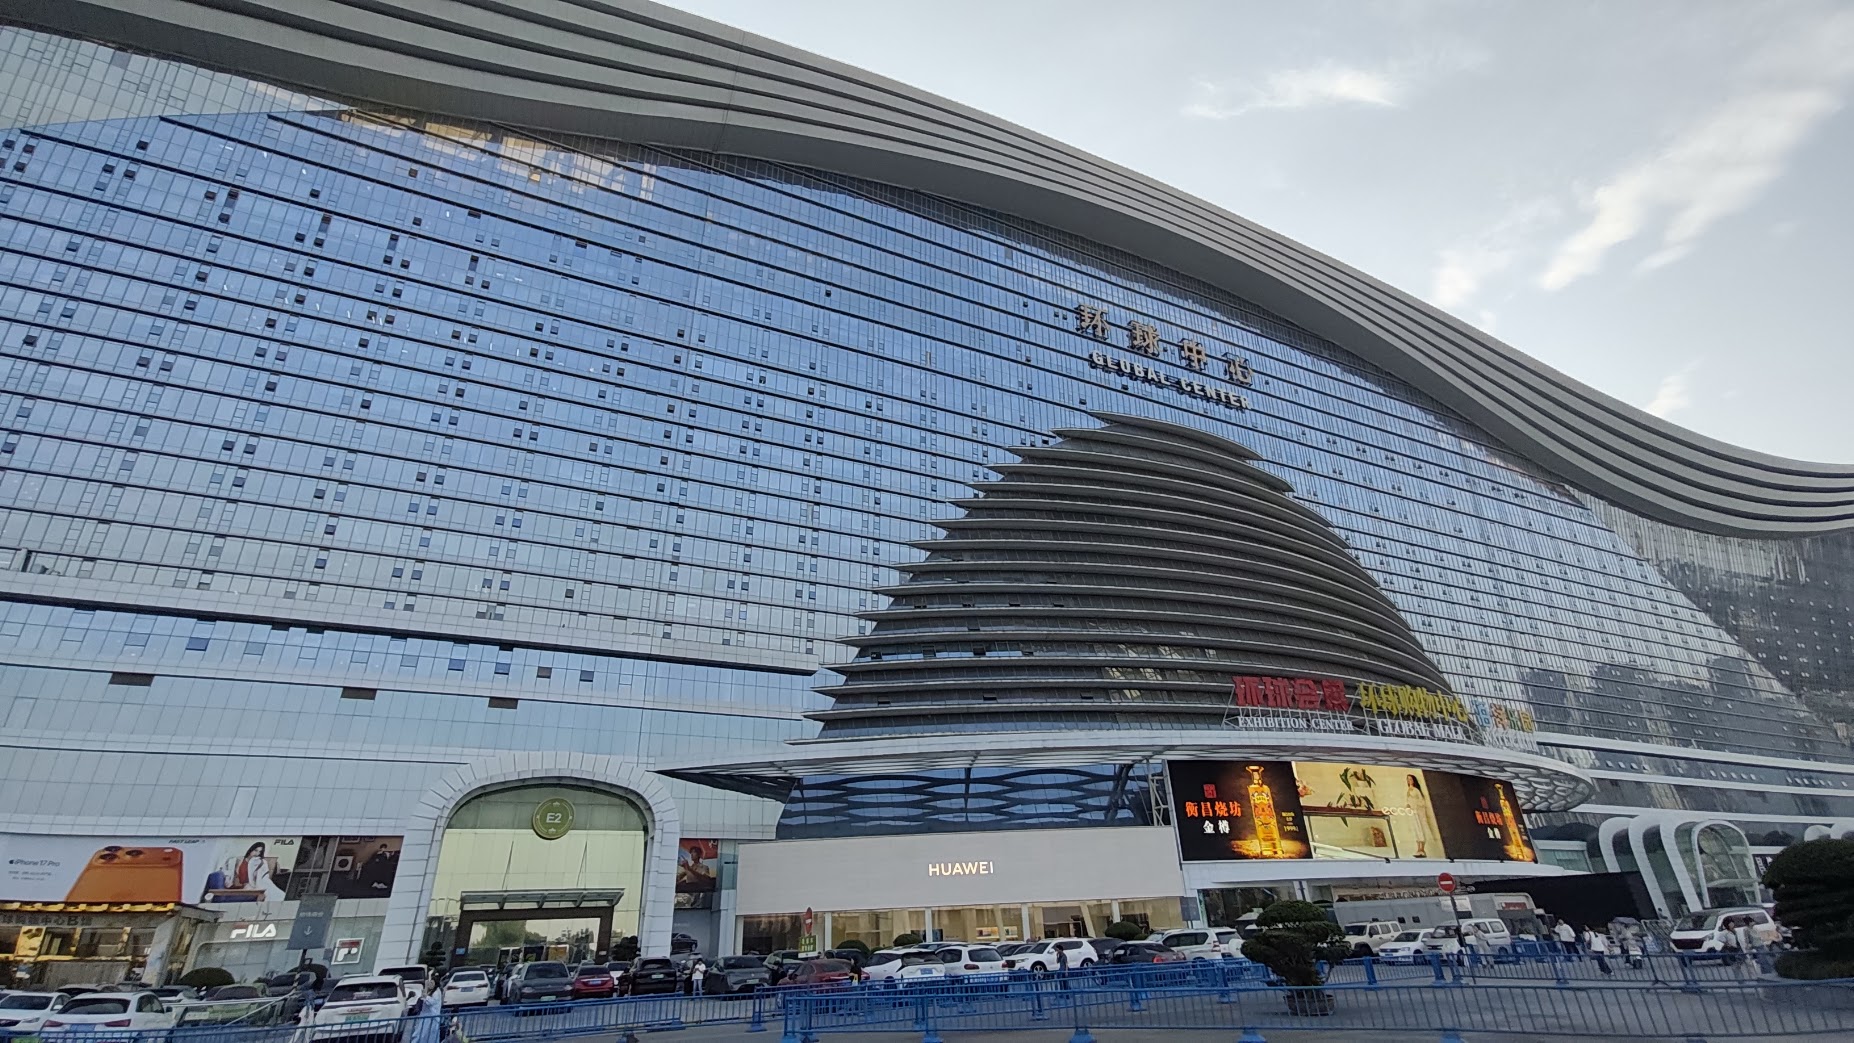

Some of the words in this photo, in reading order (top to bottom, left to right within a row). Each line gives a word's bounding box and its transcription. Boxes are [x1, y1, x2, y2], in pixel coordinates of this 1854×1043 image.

[1077, 304, 1255, 386] 环球中心
[1092, 350, 1171, 386] GLOBAL
[1180, 378, 1251, 409] CENTER
[1232, 676, 1351, 711] 环球会展
[1356, 681, 1469, 722] 环球购物中心
[1238, 716, 1308, 730] EXHIBITION
[1311, 718, 1354, 731] CENTER
[1379, 719, 1431, 737] GLOBAL
[1433, 723, 1468, 740] MALL
[1185, 801, 1242, 817] 衡昌烧坊
[1381, 806, 1414, 816] ecco
[546, 812, 562, 823] E2
[1203, 820, 1230, 834] 金樽
[928, 861, 994, 877] HUAWEI
[229, 922, 277, 939] FILA
